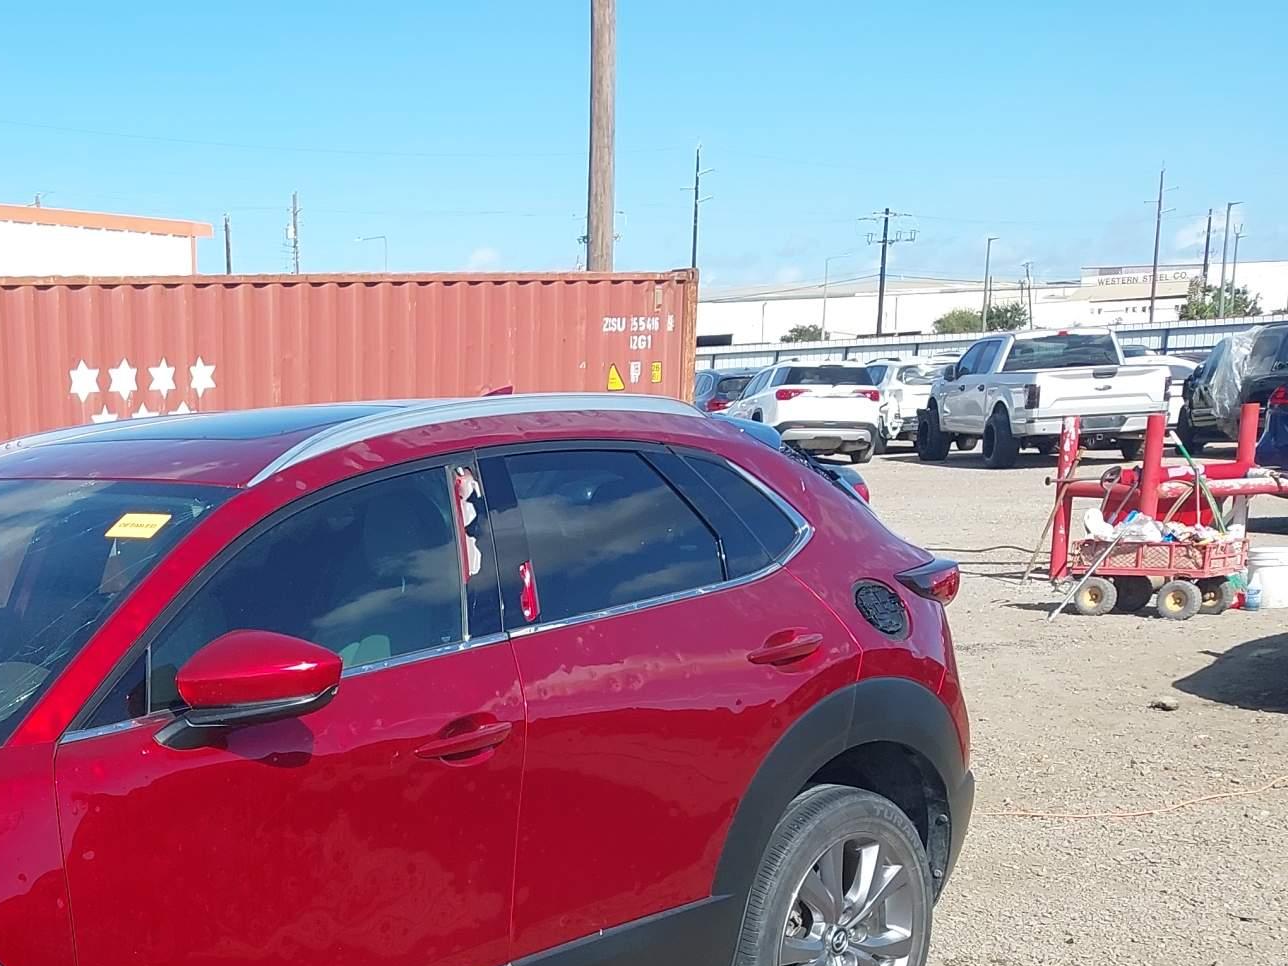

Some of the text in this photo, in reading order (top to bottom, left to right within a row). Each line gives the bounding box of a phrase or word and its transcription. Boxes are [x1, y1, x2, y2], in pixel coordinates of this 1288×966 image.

[1098, 271, 1189, 287] WESTERN STEL CO.
